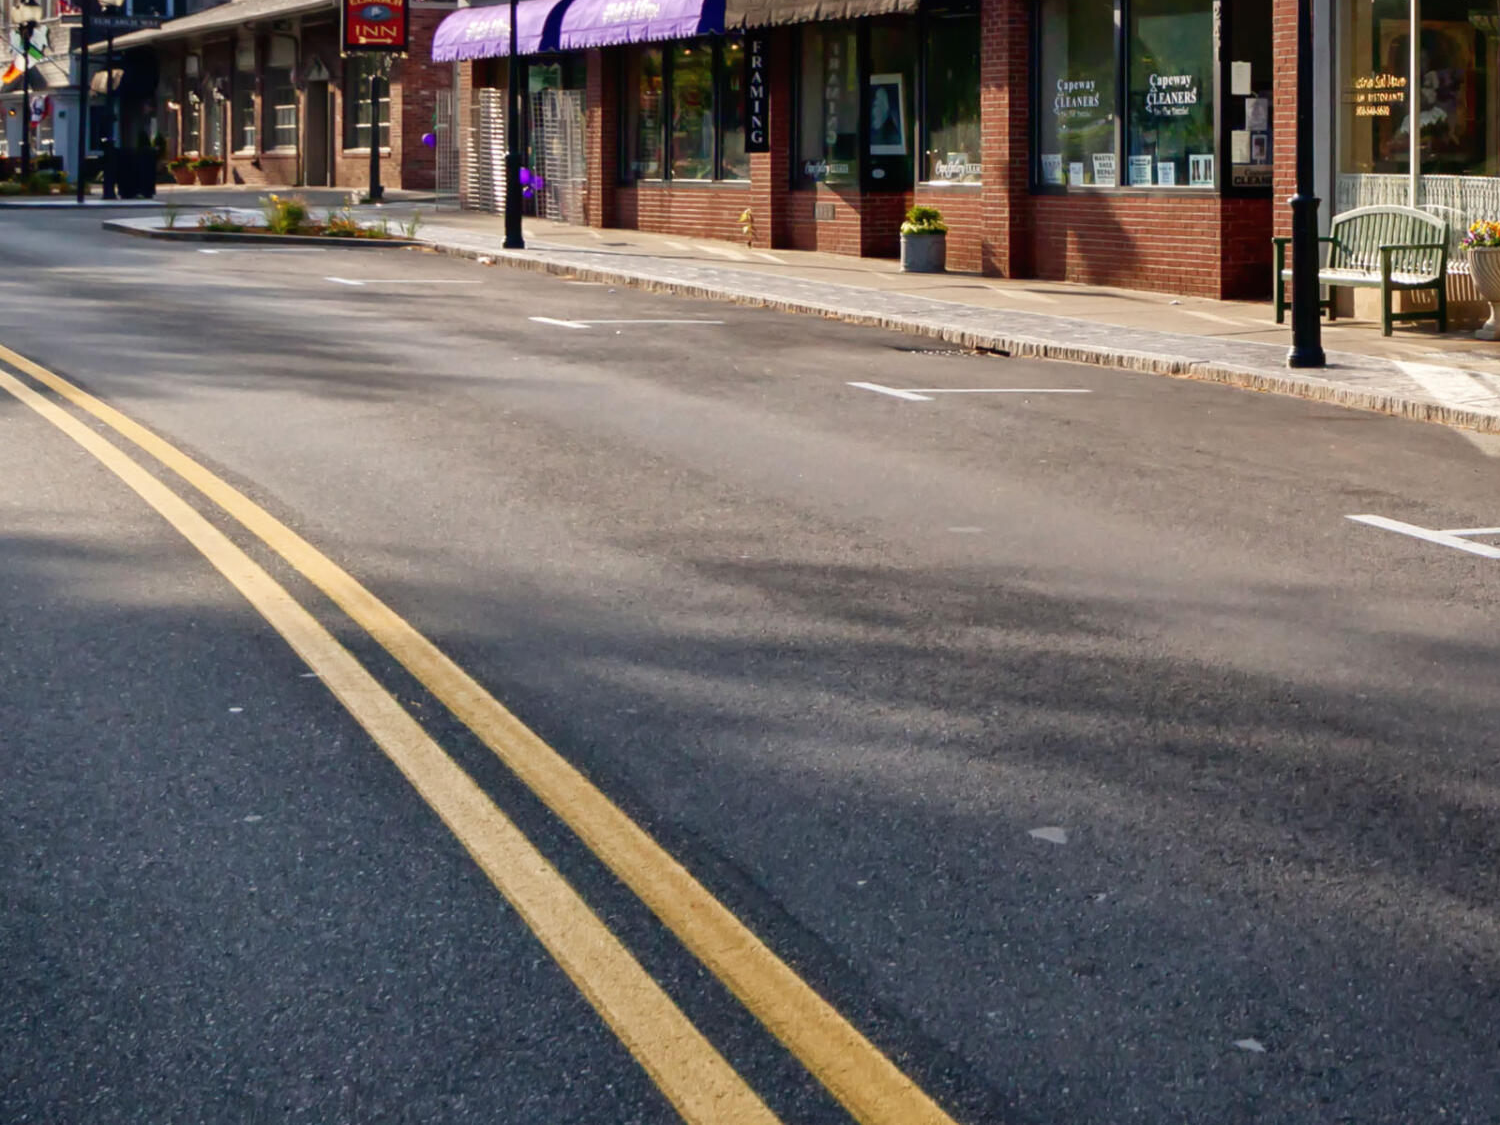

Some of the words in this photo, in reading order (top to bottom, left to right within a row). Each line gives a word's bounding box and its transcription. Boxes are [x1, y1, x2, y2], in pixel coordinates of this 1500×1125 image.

[355, 24, 397, 37] INN
[1056, 78, 1096, 92] Capeway
[1149, 73, 1192, 88] Capeway
[750, 40, 764, 144] FRAMING
[1146, 89, 1197, 105] CLEANERS
[1054, 94, 1099, 108] CLEANERS
